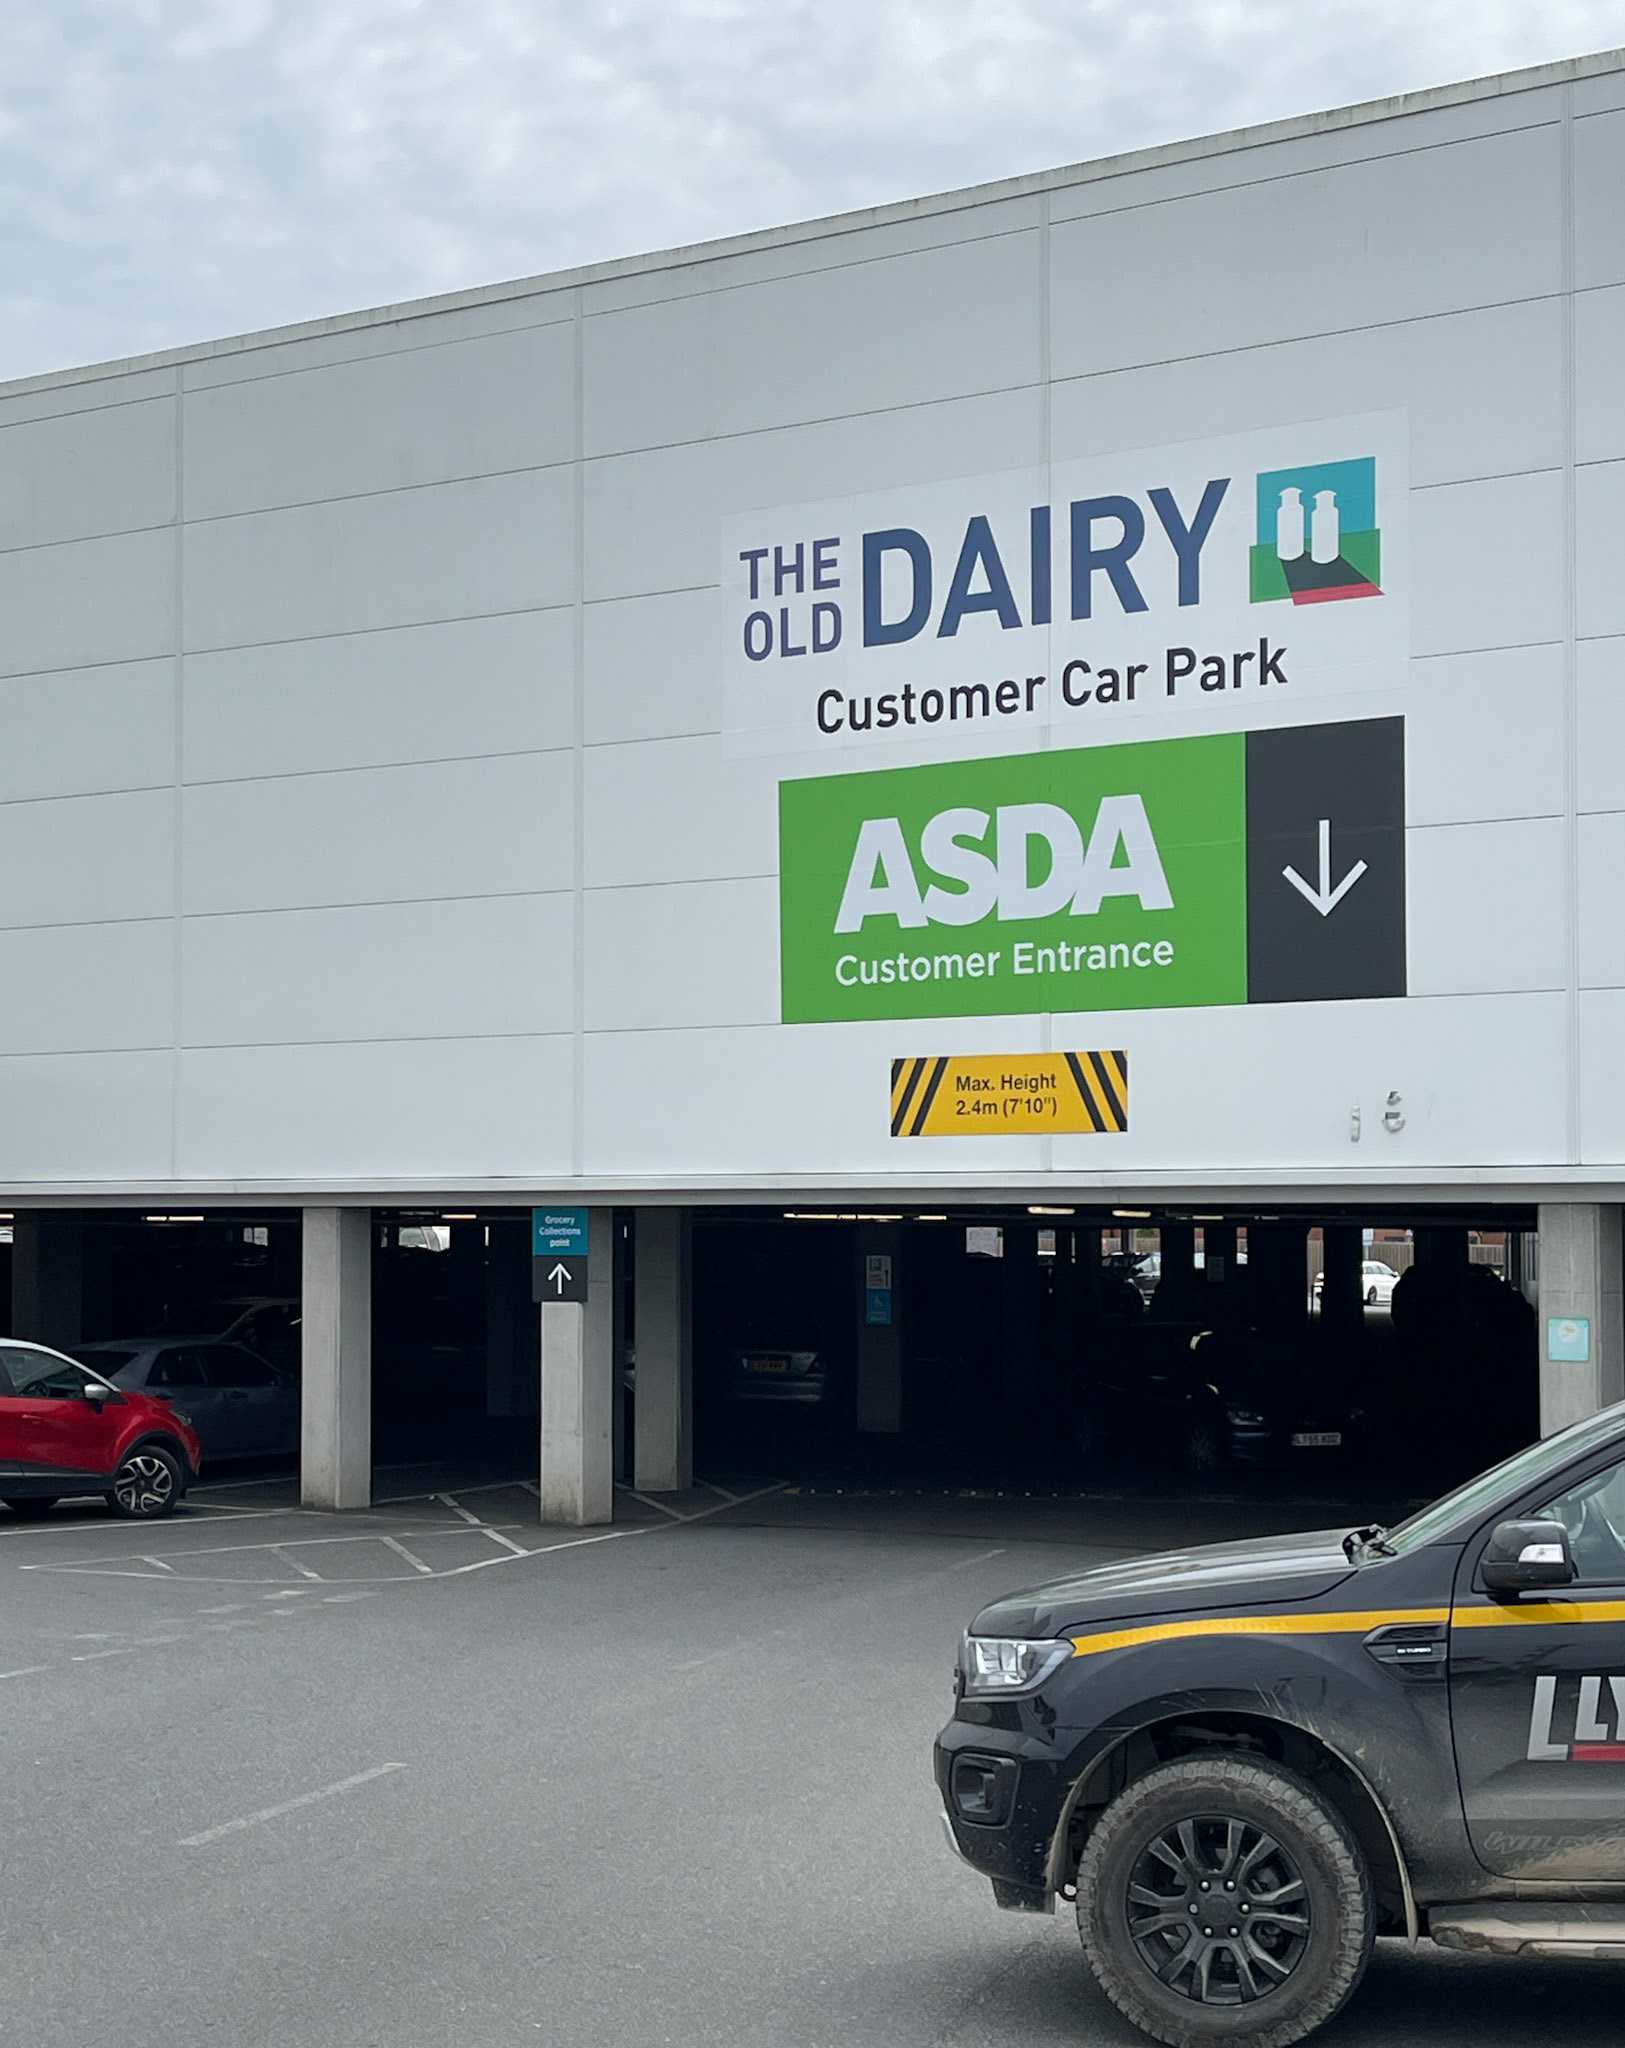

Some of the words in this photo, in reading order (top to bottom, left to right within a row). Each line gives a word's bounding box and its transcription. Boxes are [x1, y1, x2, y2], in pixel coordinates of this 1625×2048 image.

[740, 537, 841, 600] THE
[862, 477, 1232, 648] DAIRY
[743, 601, 842, 662] OLD
[817, 673, 1046, 734] Customer
[1062, 659, 1149, 707] Car
[1166, 637, 1288, 696] Park
[833, 793, 1175, 934] ASDA
[835, 950, 1000, 986] Customer
[1013, 939, 1174, 976] Entrance
[956, 1075, 996, 1092] Max.
[1000, 1073, 1057, 1094] Height
[956, 1099, 998, 1116] 2.4m
[539, 1227, 582, 1236] Collections
[545, 1215, 575, 1226] Grocery
[549, 1239, 571, 1248] point
